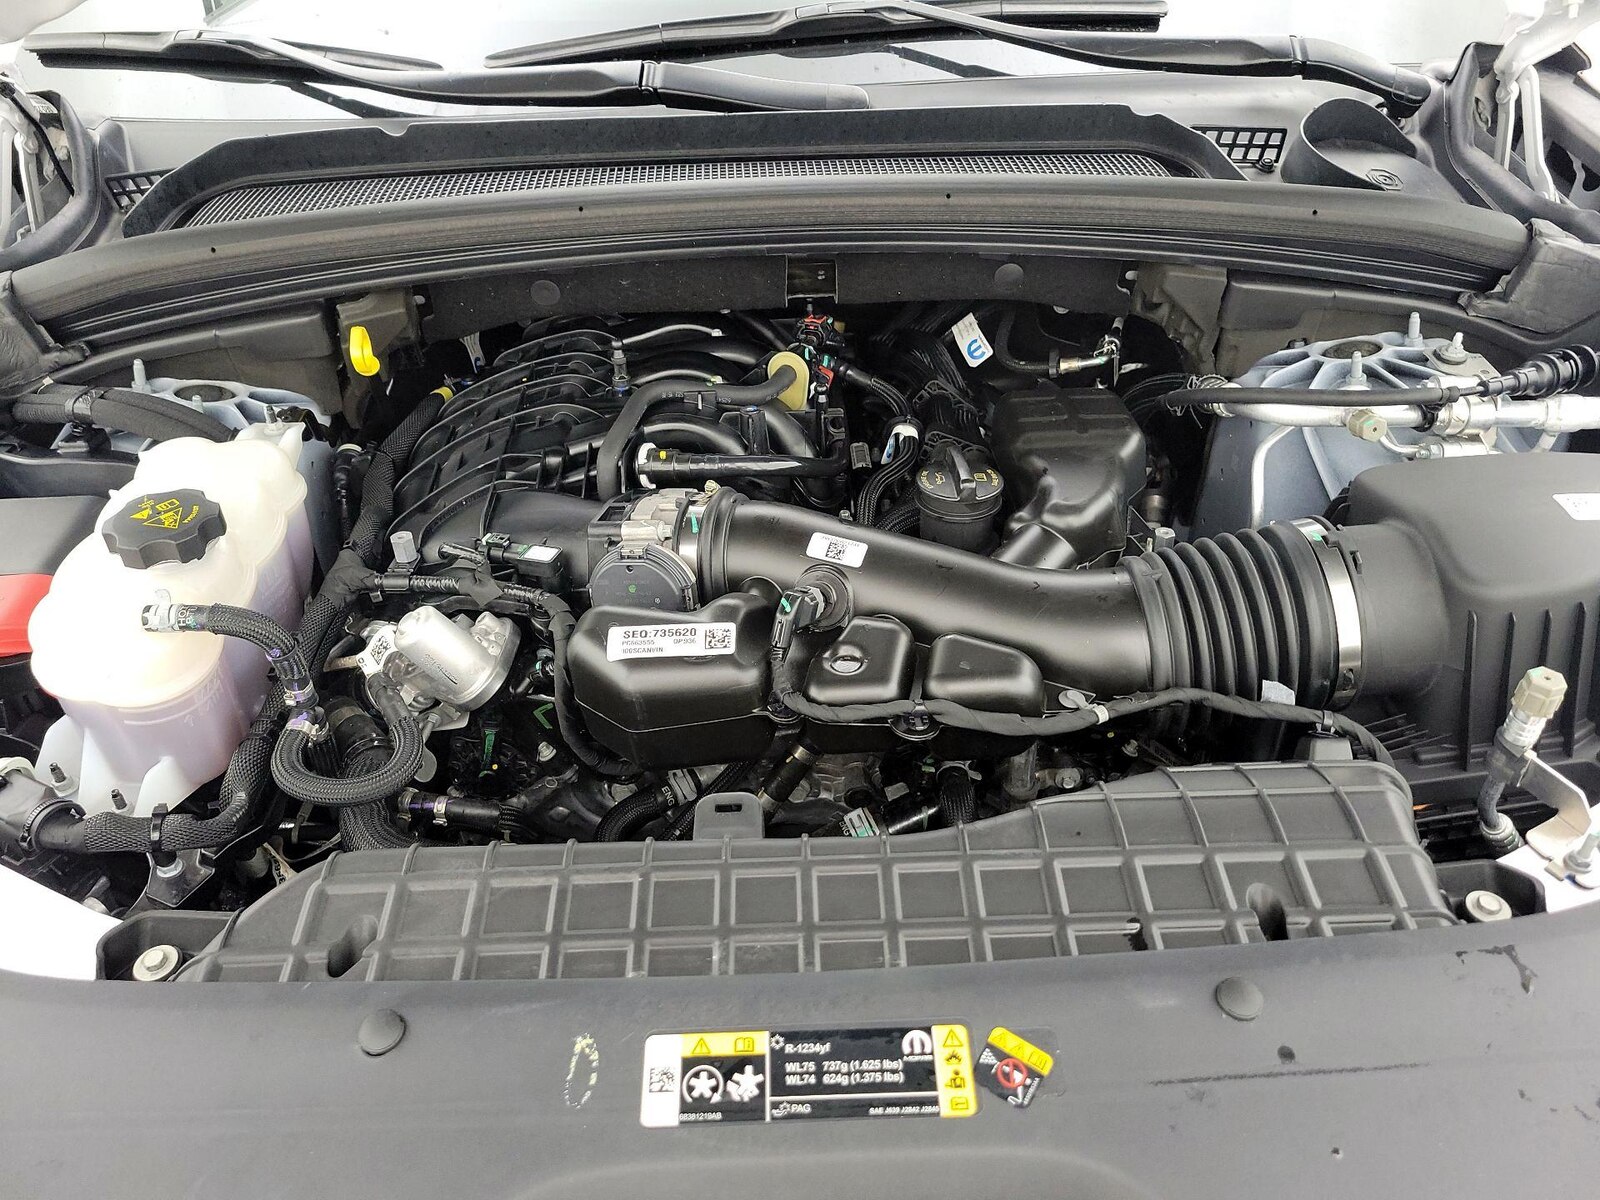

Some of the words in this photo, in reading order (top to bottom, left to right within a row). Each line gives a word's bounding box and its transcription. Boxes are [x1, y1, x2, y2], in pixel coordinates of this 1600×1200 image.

[623, 627, 697, 639] SEQ:735620
[661, 785, 675, 806] ENG
[838, 820, 851, 836] ENG
[784, 1042, 831, 1055] R-1234yf
[784, 1061, 816, 1073] WL75
[821, 1060, 849, 1074] 737g
[849, 1059, 881, 1072] (1.625
[882, 1058, 904, 1071] lbs)
[784, 1073, 816, 1086] WL74
[822, 1072, 850, 1087] 624g
[850, 1071, 882, 1085] (1.375
[883, 1070, 906, 1084] lbs)
[791, 1103, 812, 1114] PAG
